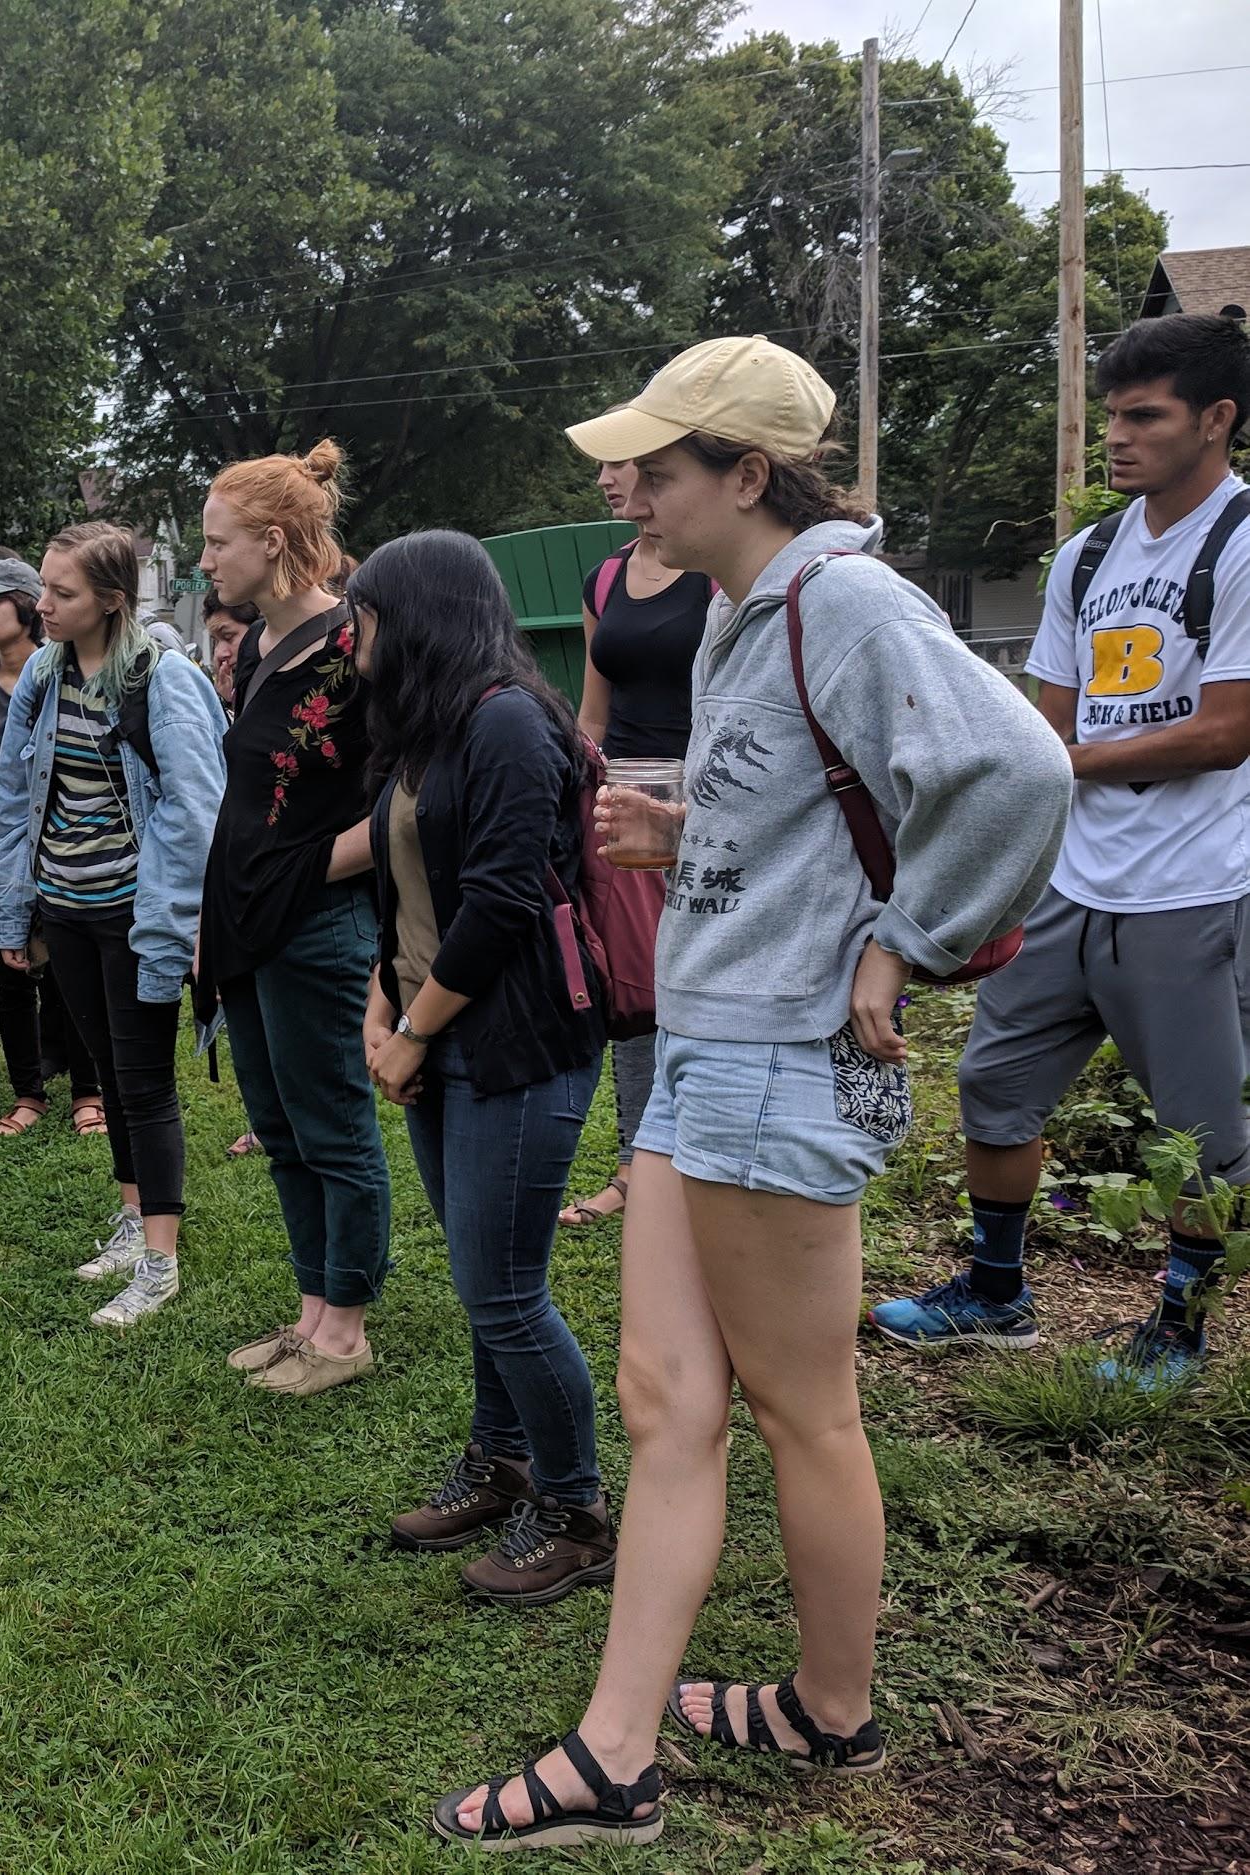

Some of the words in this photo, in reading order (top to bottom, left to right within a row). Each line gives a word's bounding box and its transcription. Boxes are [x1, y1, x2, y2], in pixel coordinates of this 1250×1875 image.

[175, 580, 207, 591] PORTER
[1080, 581, 1137, 636] BELOIT
[1129, 696, 1193, 723] FIELD
